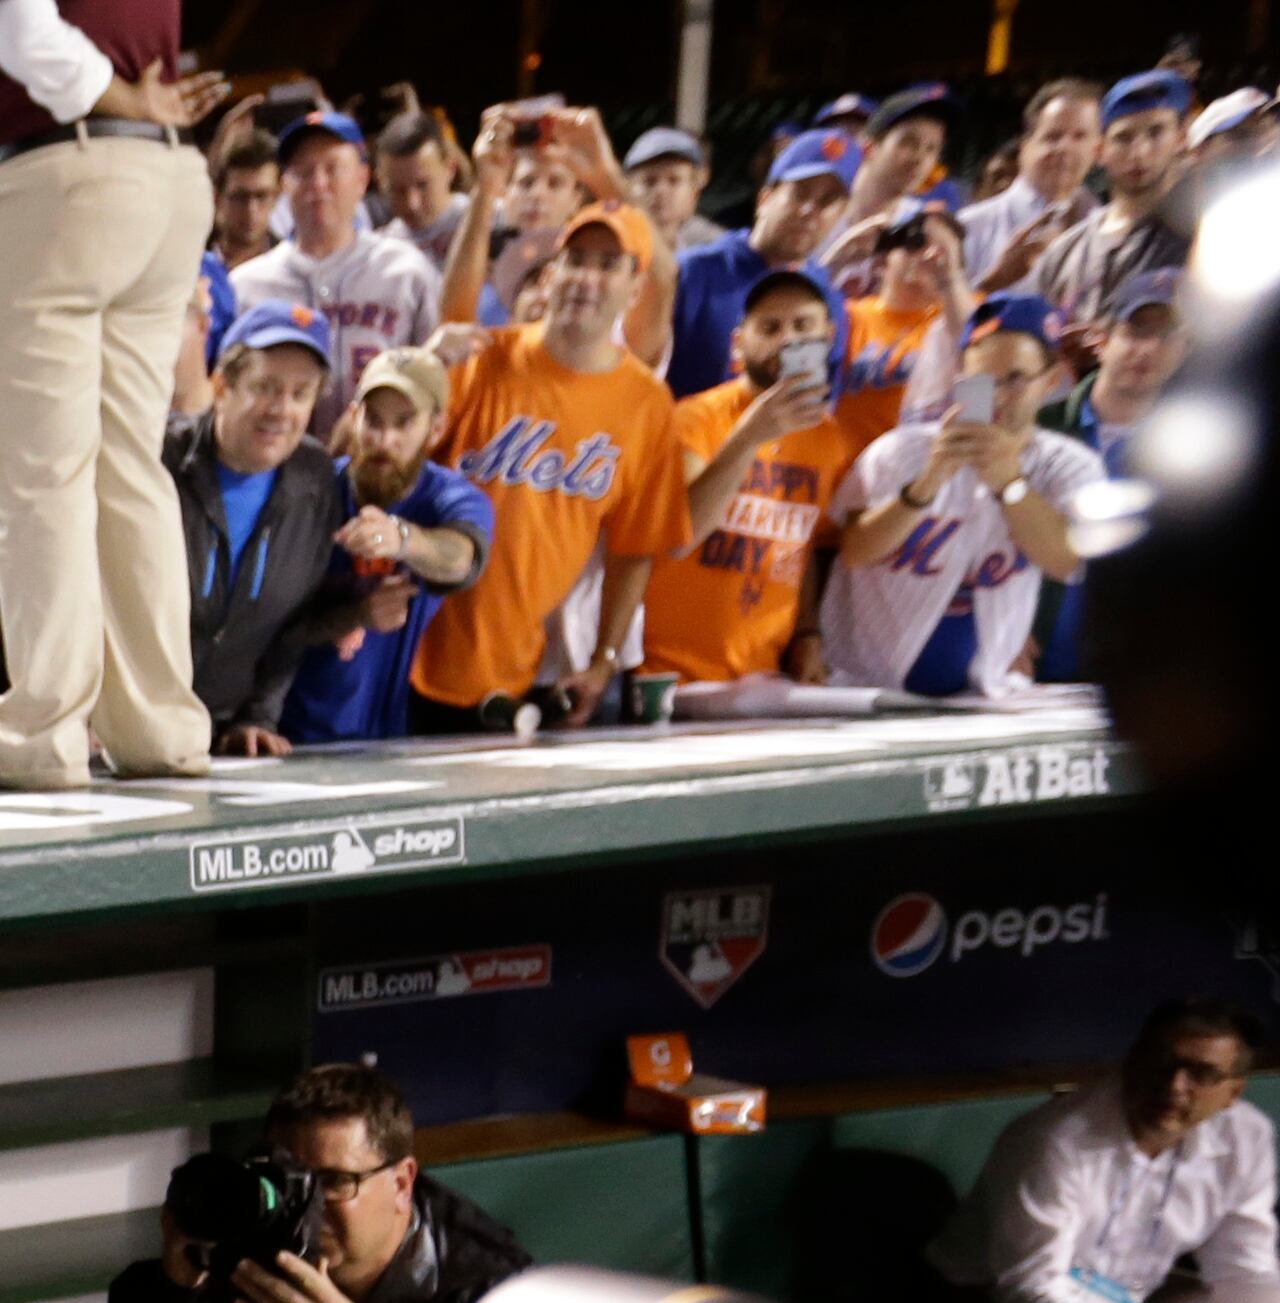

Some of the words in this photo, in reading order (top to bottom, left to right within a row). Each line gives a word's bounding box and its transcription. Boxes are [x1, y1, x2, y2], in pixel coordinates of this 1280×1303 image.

[457, 414, 622, 500] Mets
[978, 755, 1033, 806] At
[1036, 747, 1110, 800] Bat
[199, 844, 329, 883] MLB.com
[374, 826, 457, 856] shop
[951, 893, 1109, 963] pepsi
[325, 971, 435, 1004] MLB.com
